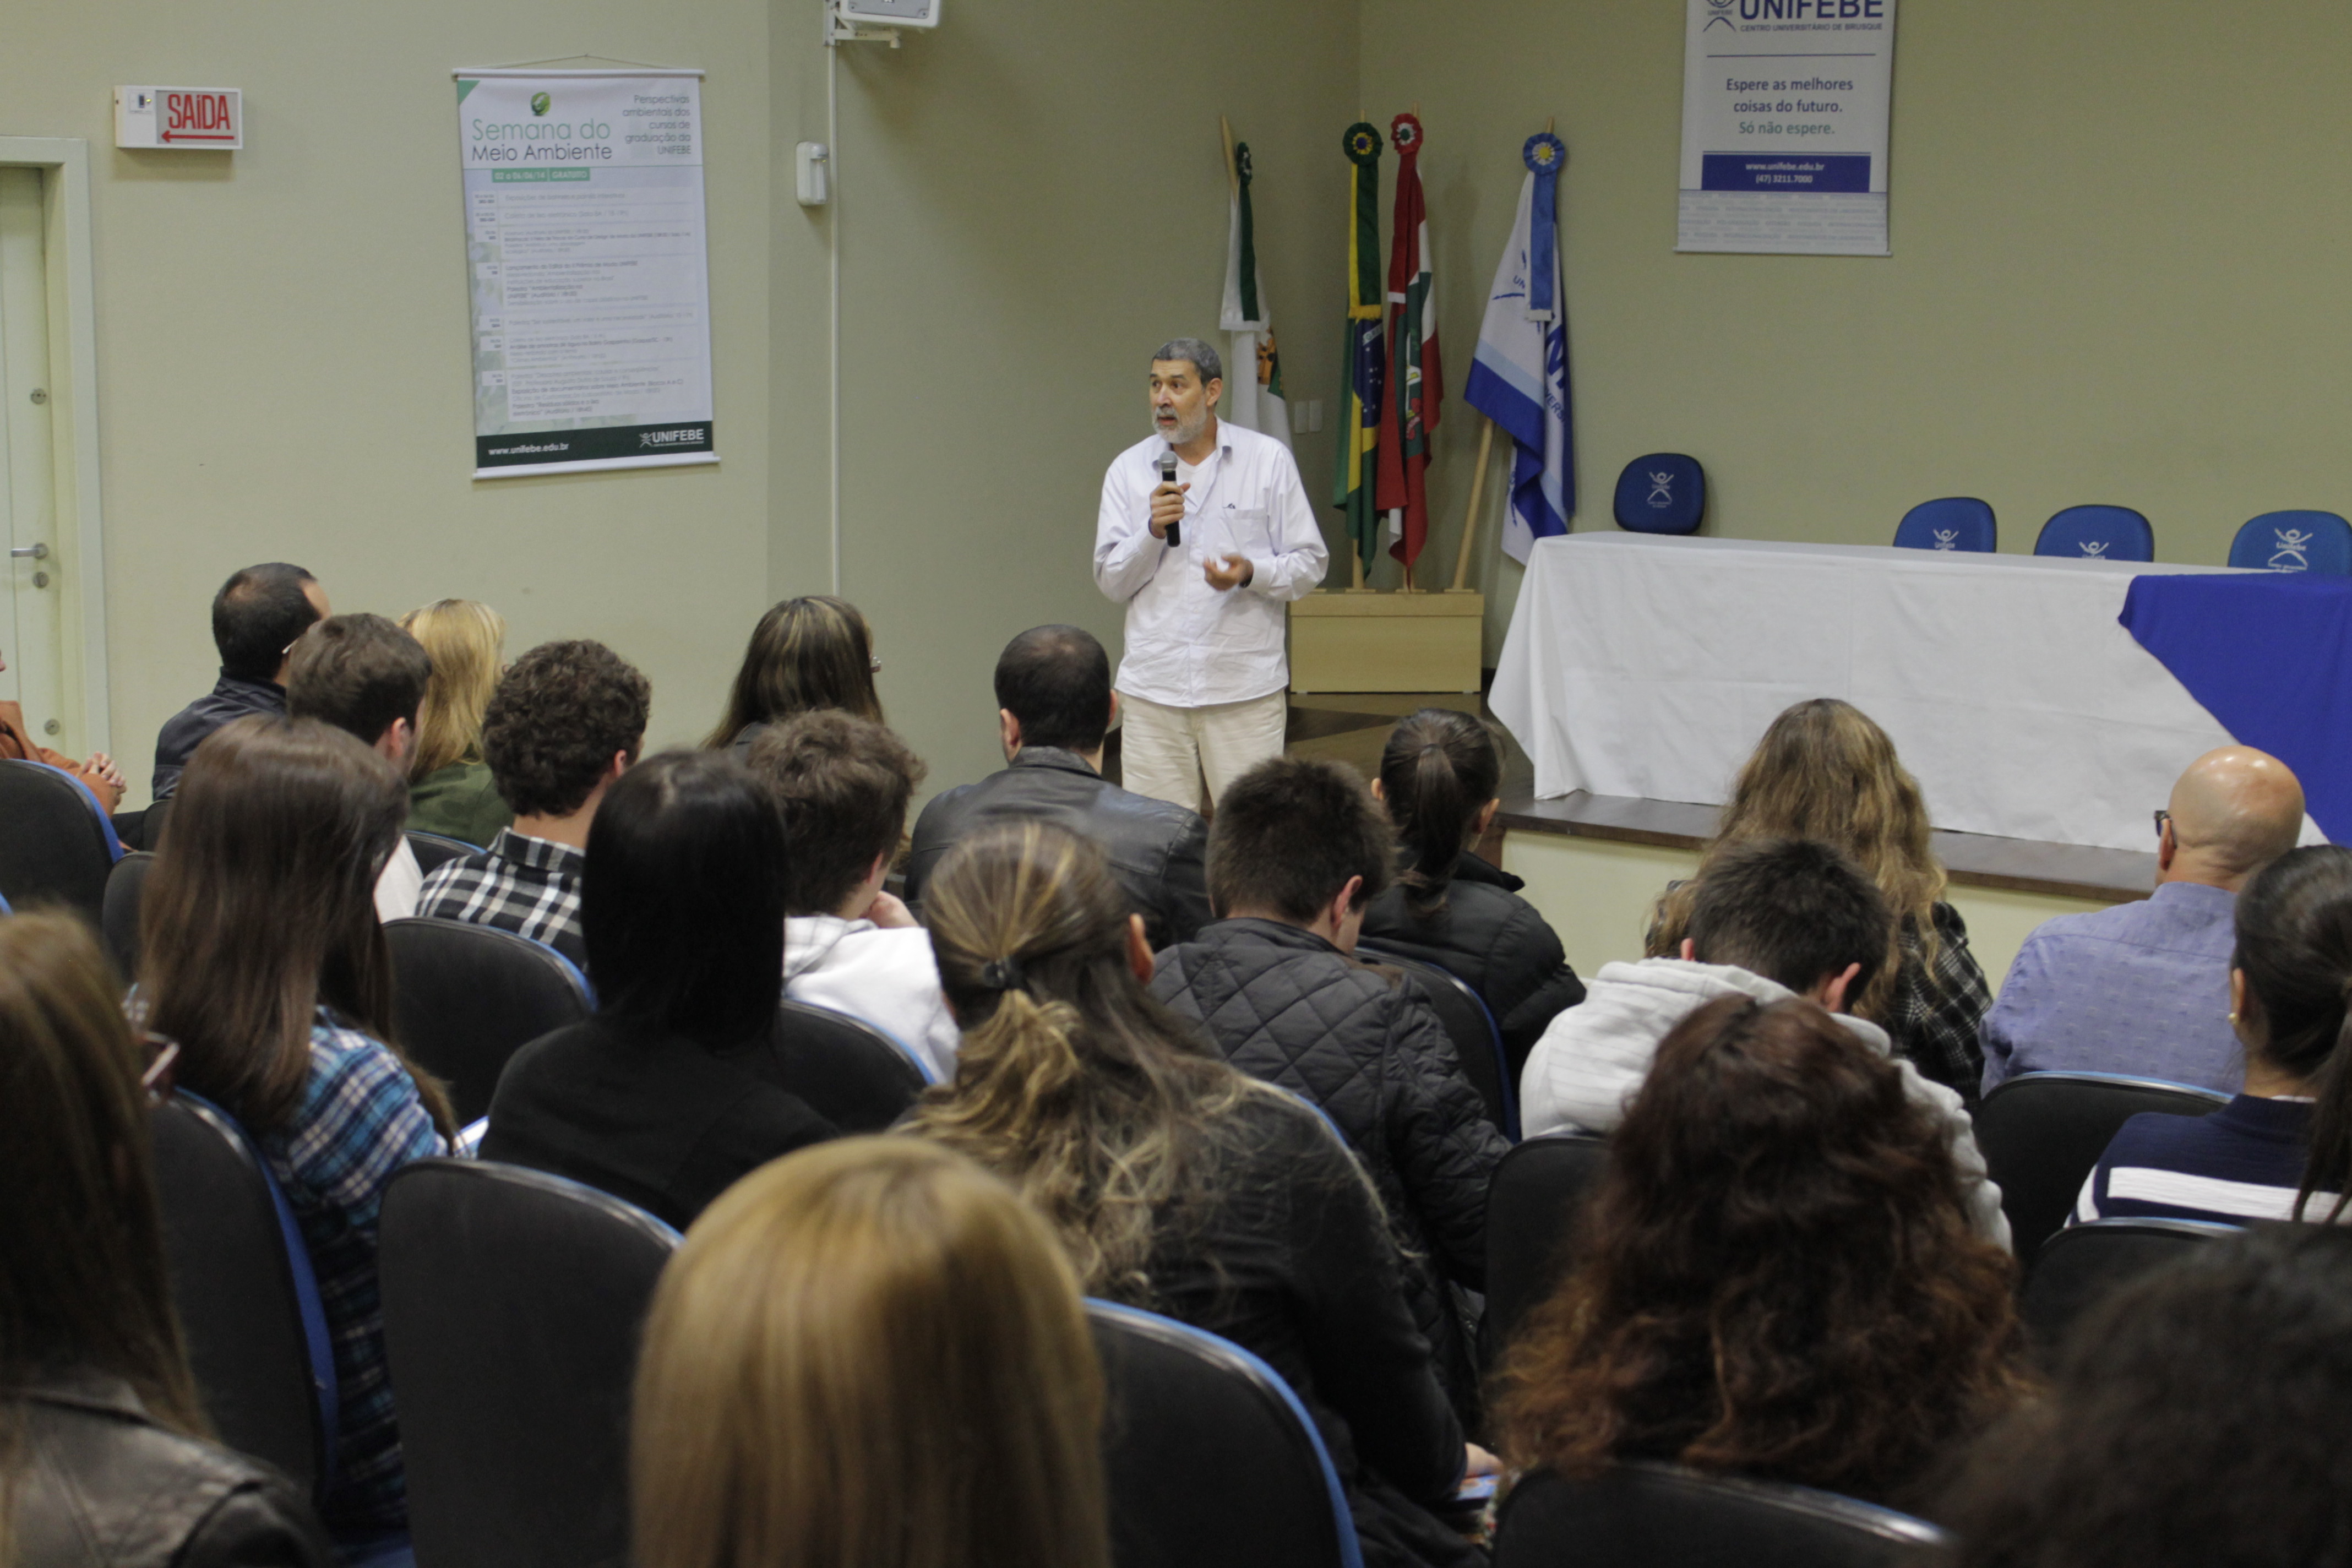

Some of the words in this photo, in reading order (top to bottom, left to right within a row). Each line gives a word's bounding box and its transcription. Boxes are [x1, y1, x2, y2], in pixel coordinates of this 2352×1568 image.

[1740, 0, 1883, 20] UNIFEBE
[1726, 78, 1769, 93] Espere
[1773, 81, 1787, 90] as
[1790, 77, 1854, 90] melhores
[634, 95, 690, 105] Perspectivas
[1734, 100, 1772, 112] coisas
[1776, 100, 1793, 112] do
[1796, 99, 1843, 112] futuro.
[622, 107, 672, 117] ambientais
[674, 108, 691, 117] dos
[472, 118, 571, 140] Semana
[580, 118, 611, 140] do
[678, 121, 691, 129] de
[1739, 121, 1755, 134] Só
[1758, 121, 1783, 134] não
[1787, 124, 1835, 137] espere.
[624, 133, 677, 144] graduação
[472, 144, 518, 161] Meio
[524, 143, 613, 160] Ambiente
[657, 145, 692, 154] UNIFEBE
[1745, 161, 1825, 171] www.unifebe.edu.br
[552, 171, 587, 179] GRATUITO
[652, 429, 704, 443] UNIFEBE
[488, 443, 569, 455] www.unifebe.edu.br
